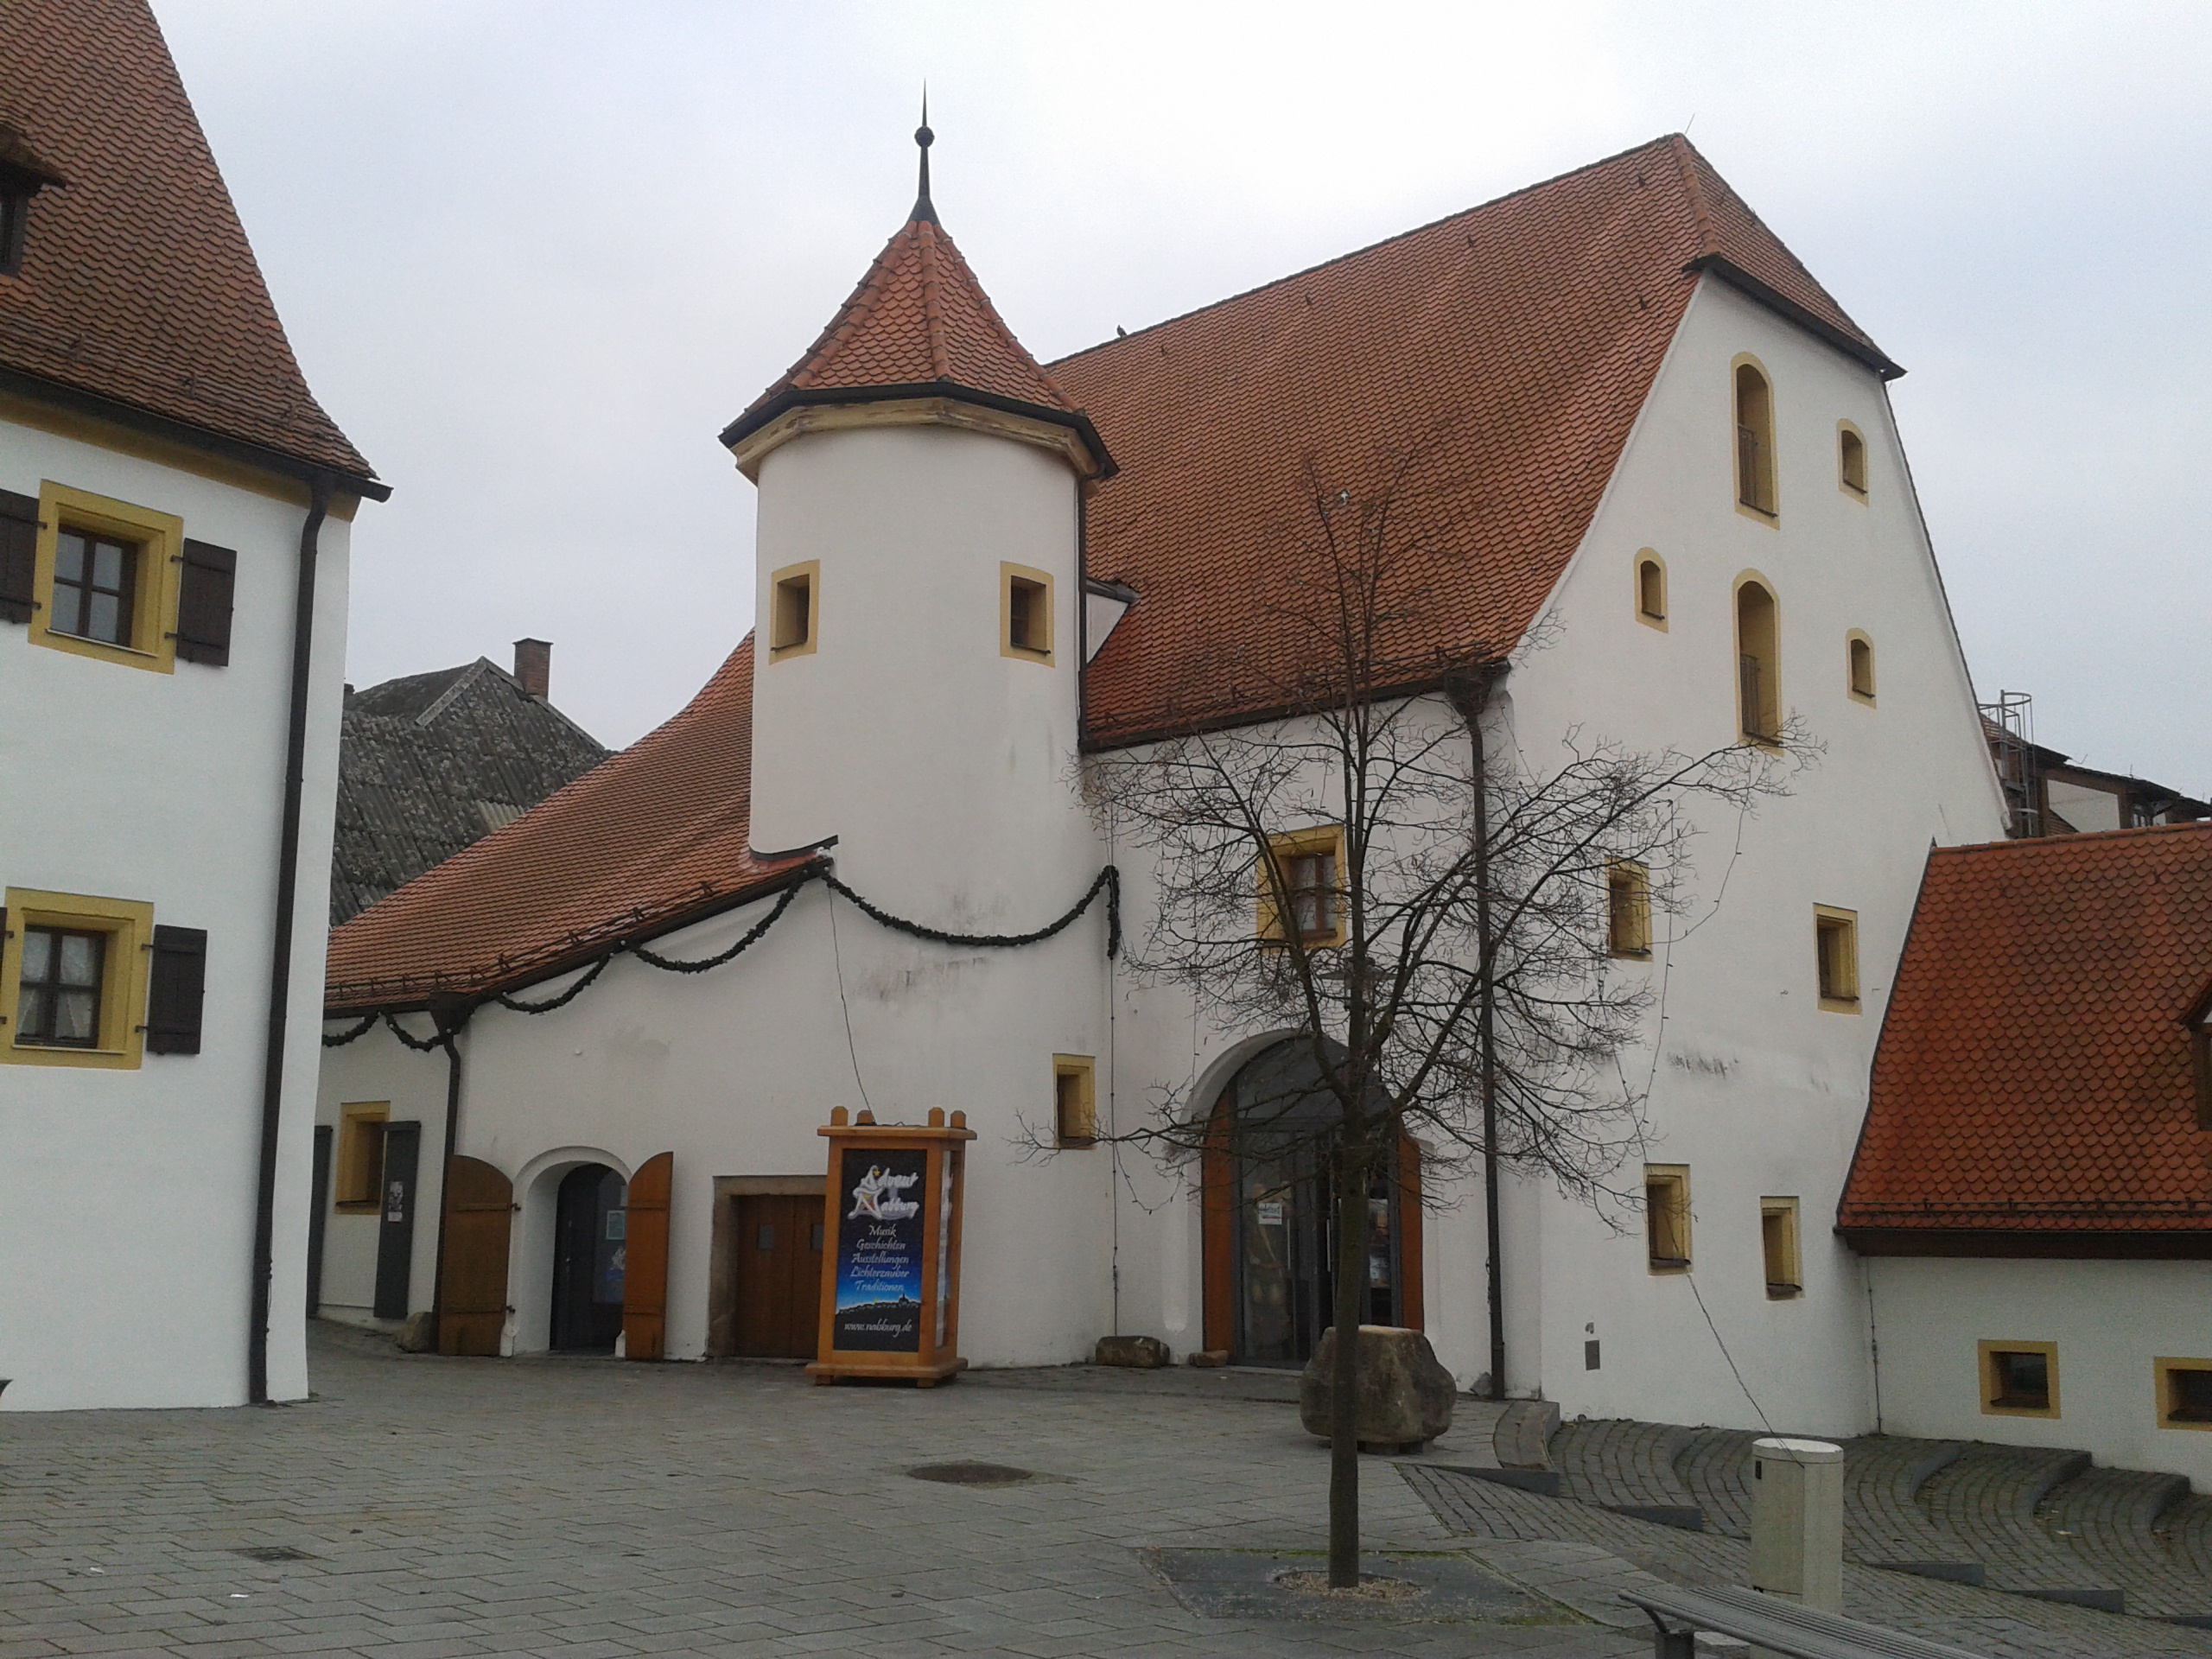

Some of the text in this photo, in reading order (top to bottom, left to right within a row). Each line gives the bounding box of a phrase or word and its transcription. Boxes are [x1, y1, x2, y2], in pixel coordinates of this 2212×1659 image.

[860, 1166, 919, 1189] Advent
[848, 1186, 919, 1219] Nabburg
[868, 1224, 897, 1237] Musik
[856, 1236, 906, 1250] Geschichten
[851, 1251, 909, 1269] Ausstellungen
[850, 1264, 910, 1277] Lichterzauber
[855, 1279, 904, 1292] Traditionen
[845, 1318, 912, 1338] www.nabburg.de
